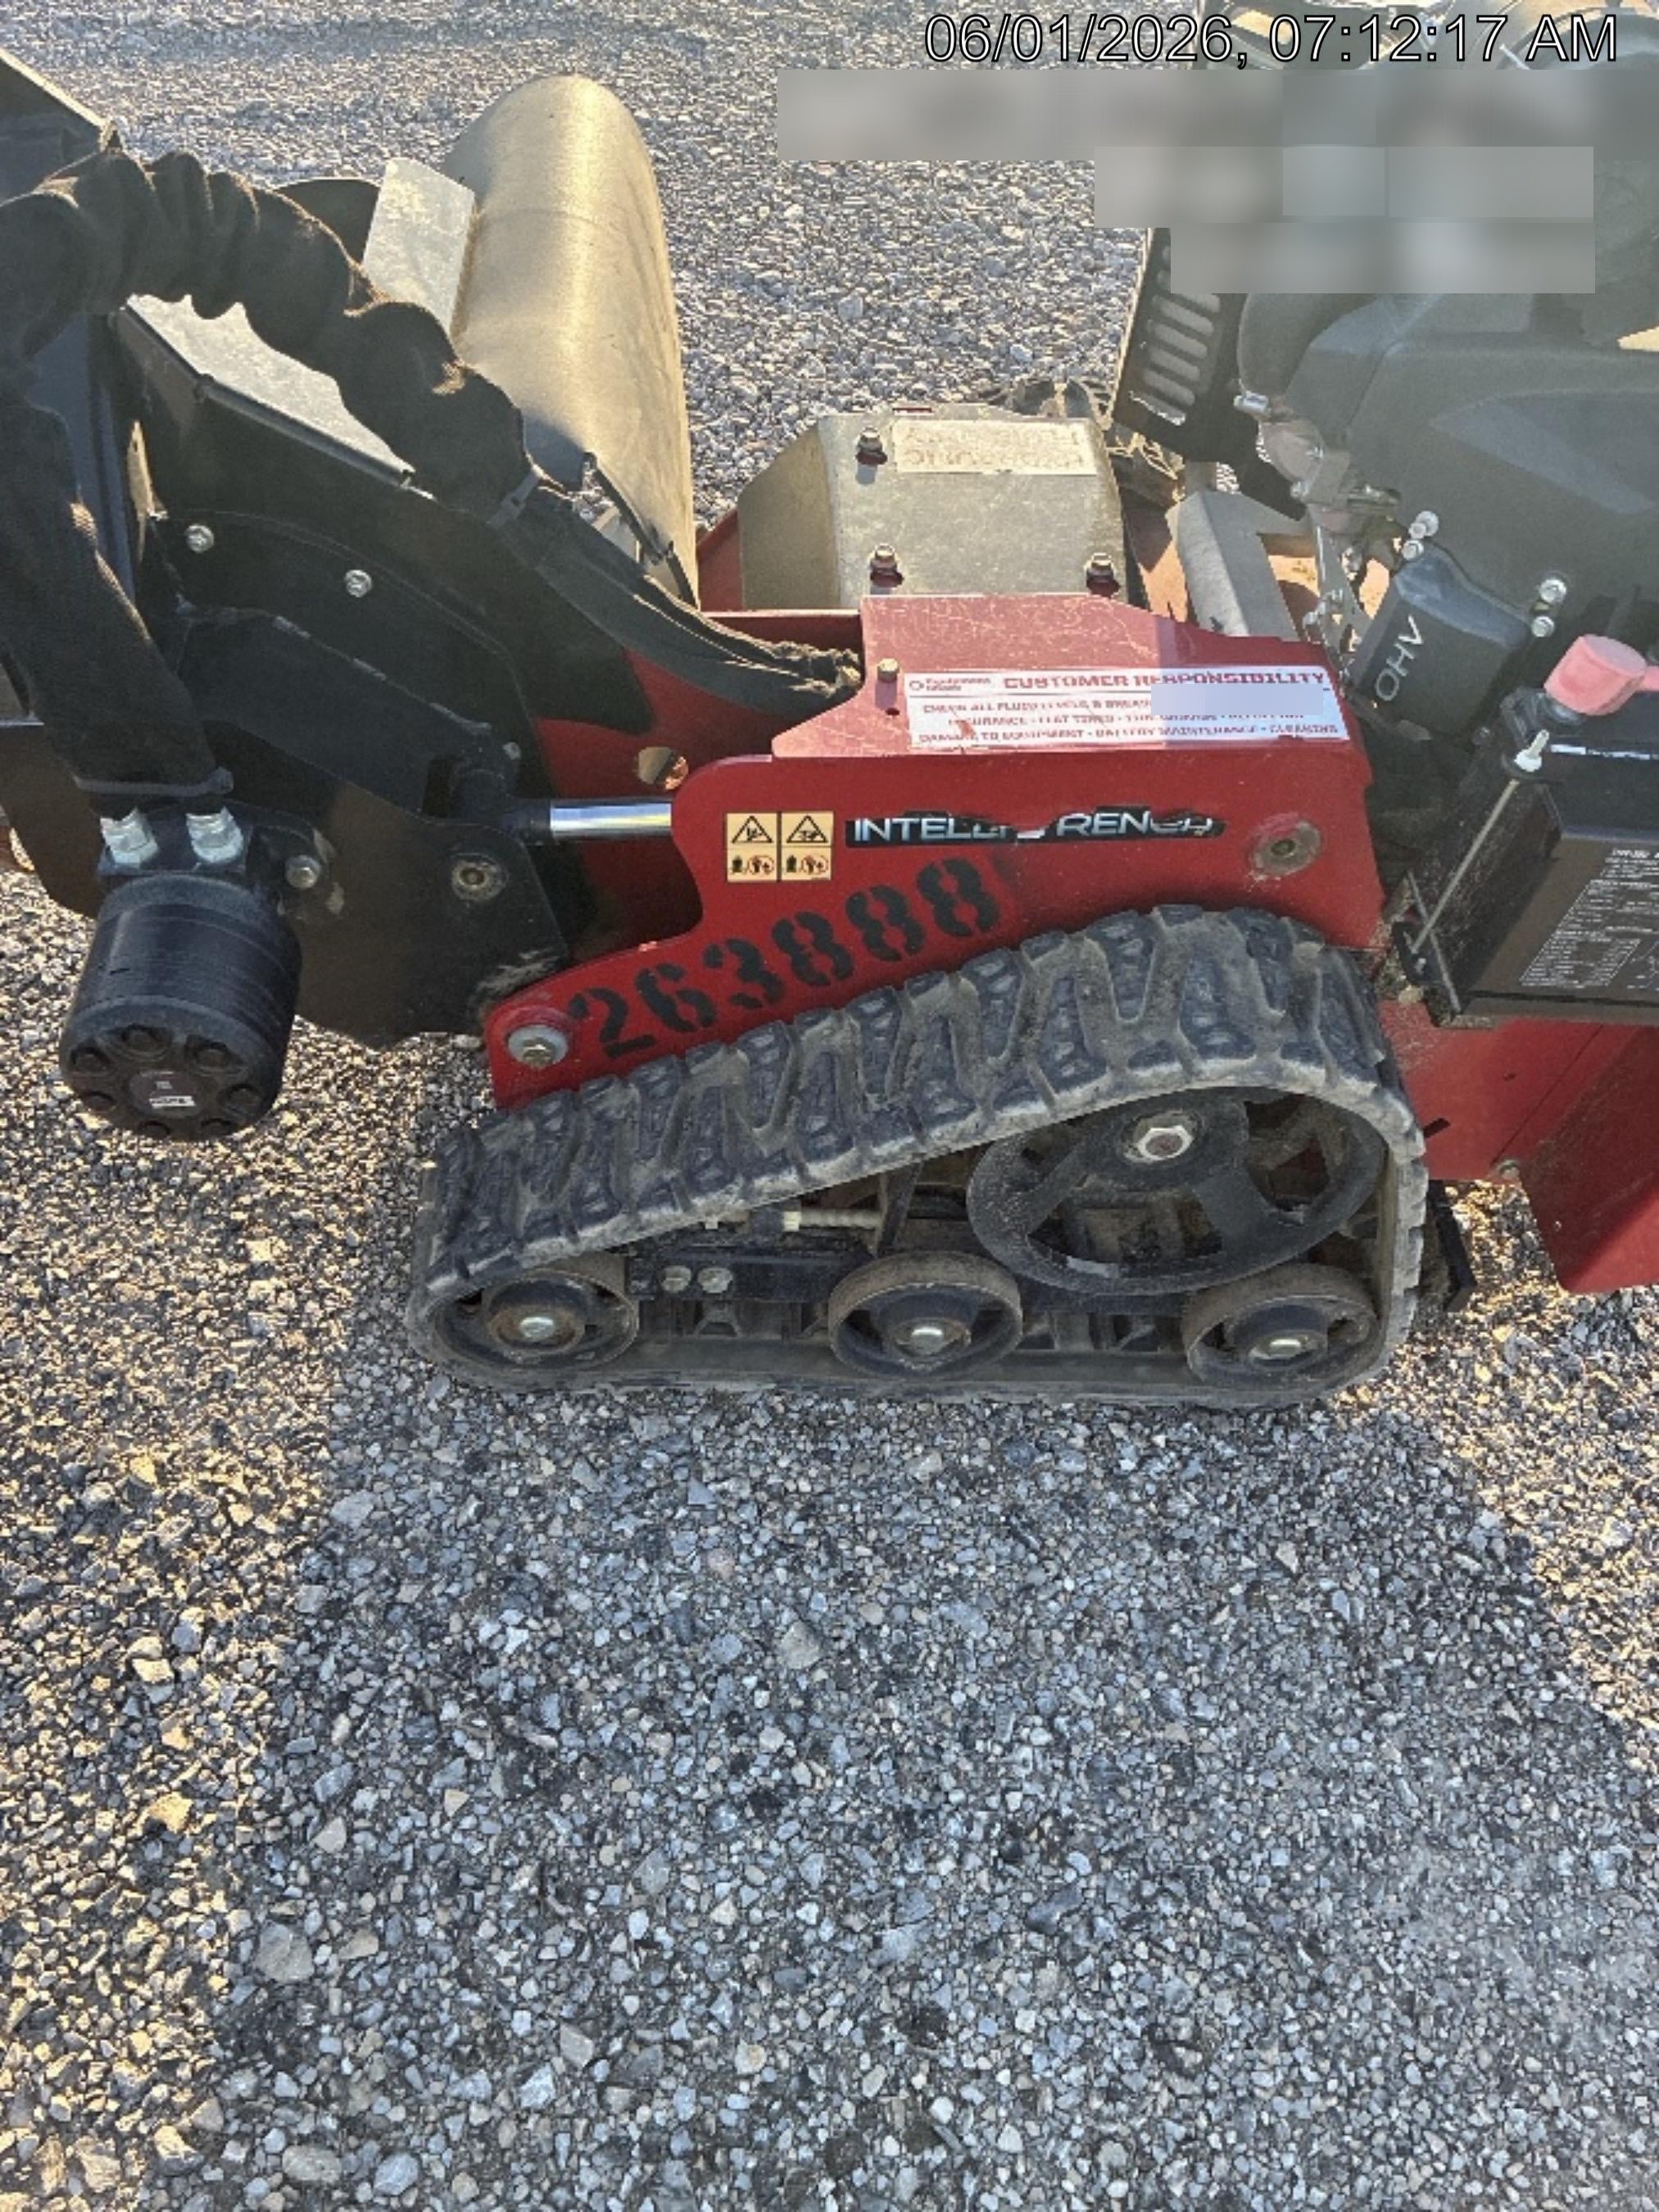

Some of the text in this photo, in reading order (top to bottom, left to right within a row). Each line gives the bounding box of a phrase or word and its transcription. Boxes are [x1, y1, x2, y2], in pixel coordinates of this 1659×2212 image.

[1004, 674, 1129, 690] CUSTOMER
[1375, 614, 1424, 702] OHV
[569, 857, 1000, 1058] 263888
